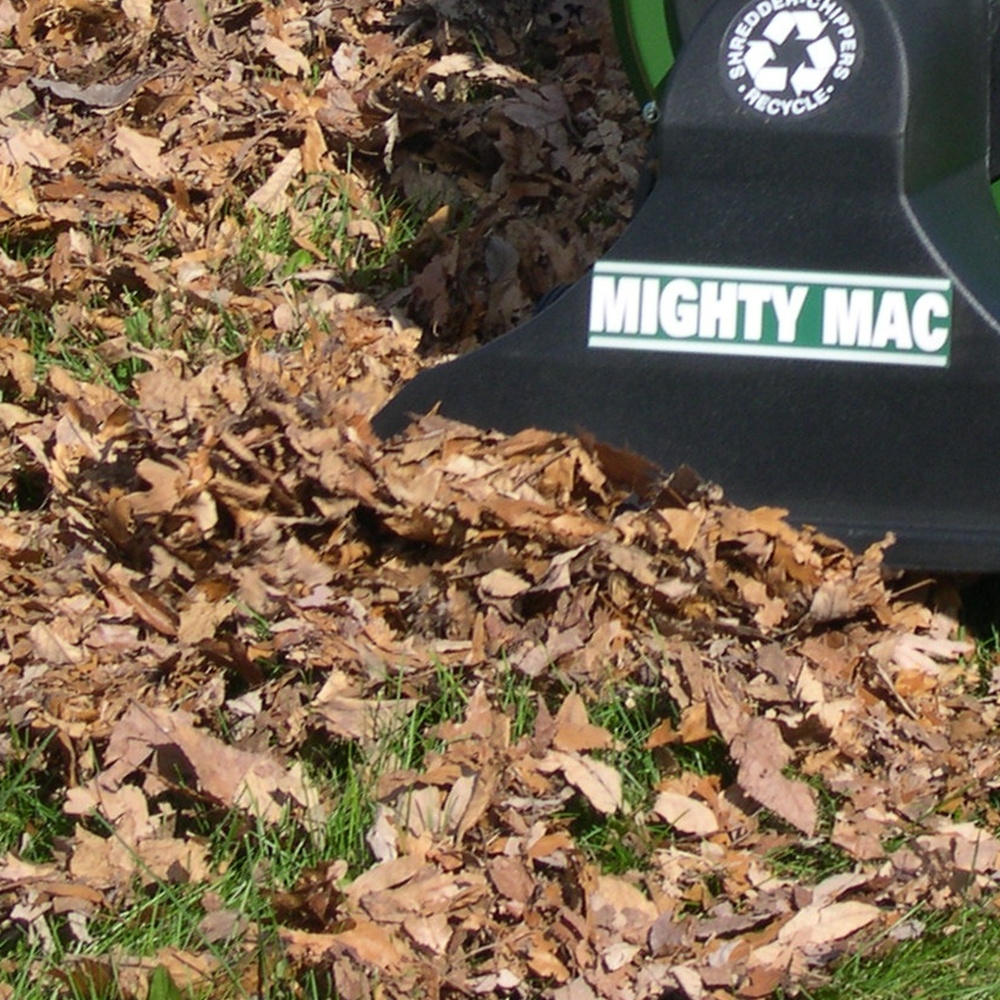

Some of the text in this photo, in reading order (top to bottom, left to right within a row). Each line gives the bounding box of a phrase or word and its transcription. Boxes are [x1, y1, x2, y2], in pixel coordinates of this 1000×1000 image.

[743, 87, 830, 116] RECYCLE
[589, 275, 951, 353] MIGHTY MAC
